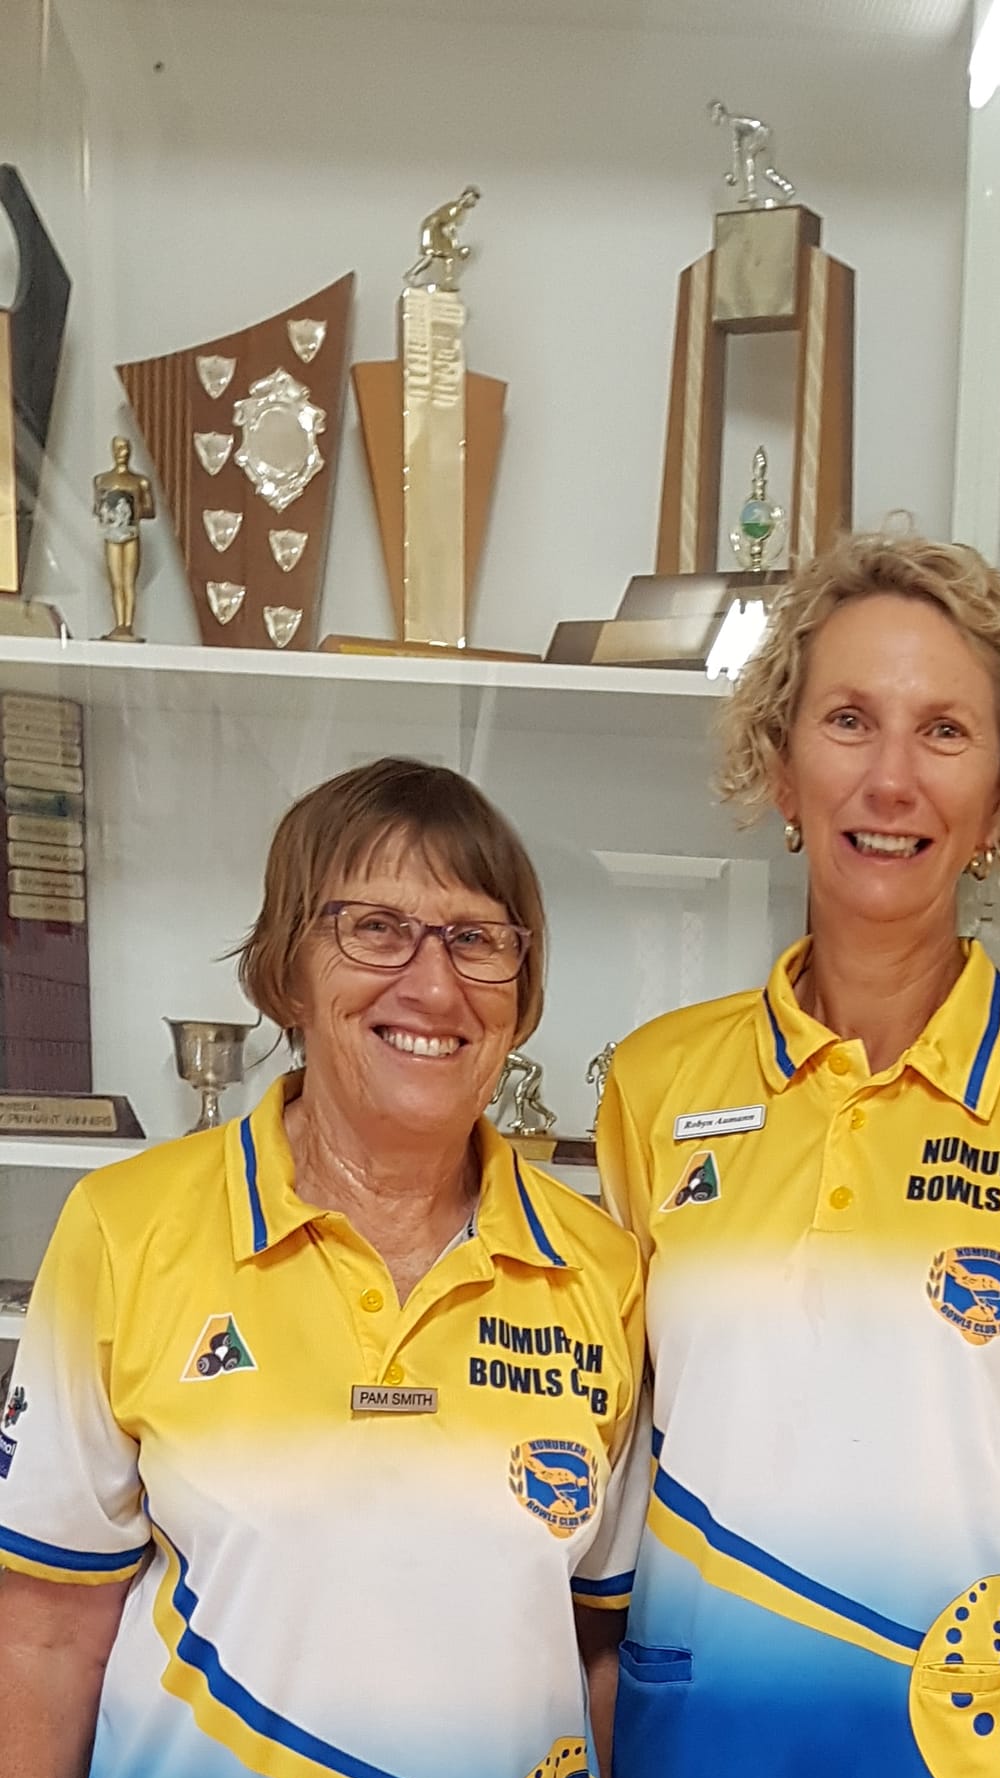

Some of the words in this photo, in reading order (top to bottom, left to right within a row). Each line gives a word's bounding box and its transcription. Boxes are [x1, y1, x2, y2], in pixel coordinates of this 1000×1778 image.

[940, 1304, 973, 1330] BOWLS
[974, 1322, 998, 1335] CLUB
[469, 1357, 564, 1398] BOWLS
[359, 1391, 388, 1405] PAM
[391, 1392, 433, 1406] SMITH
